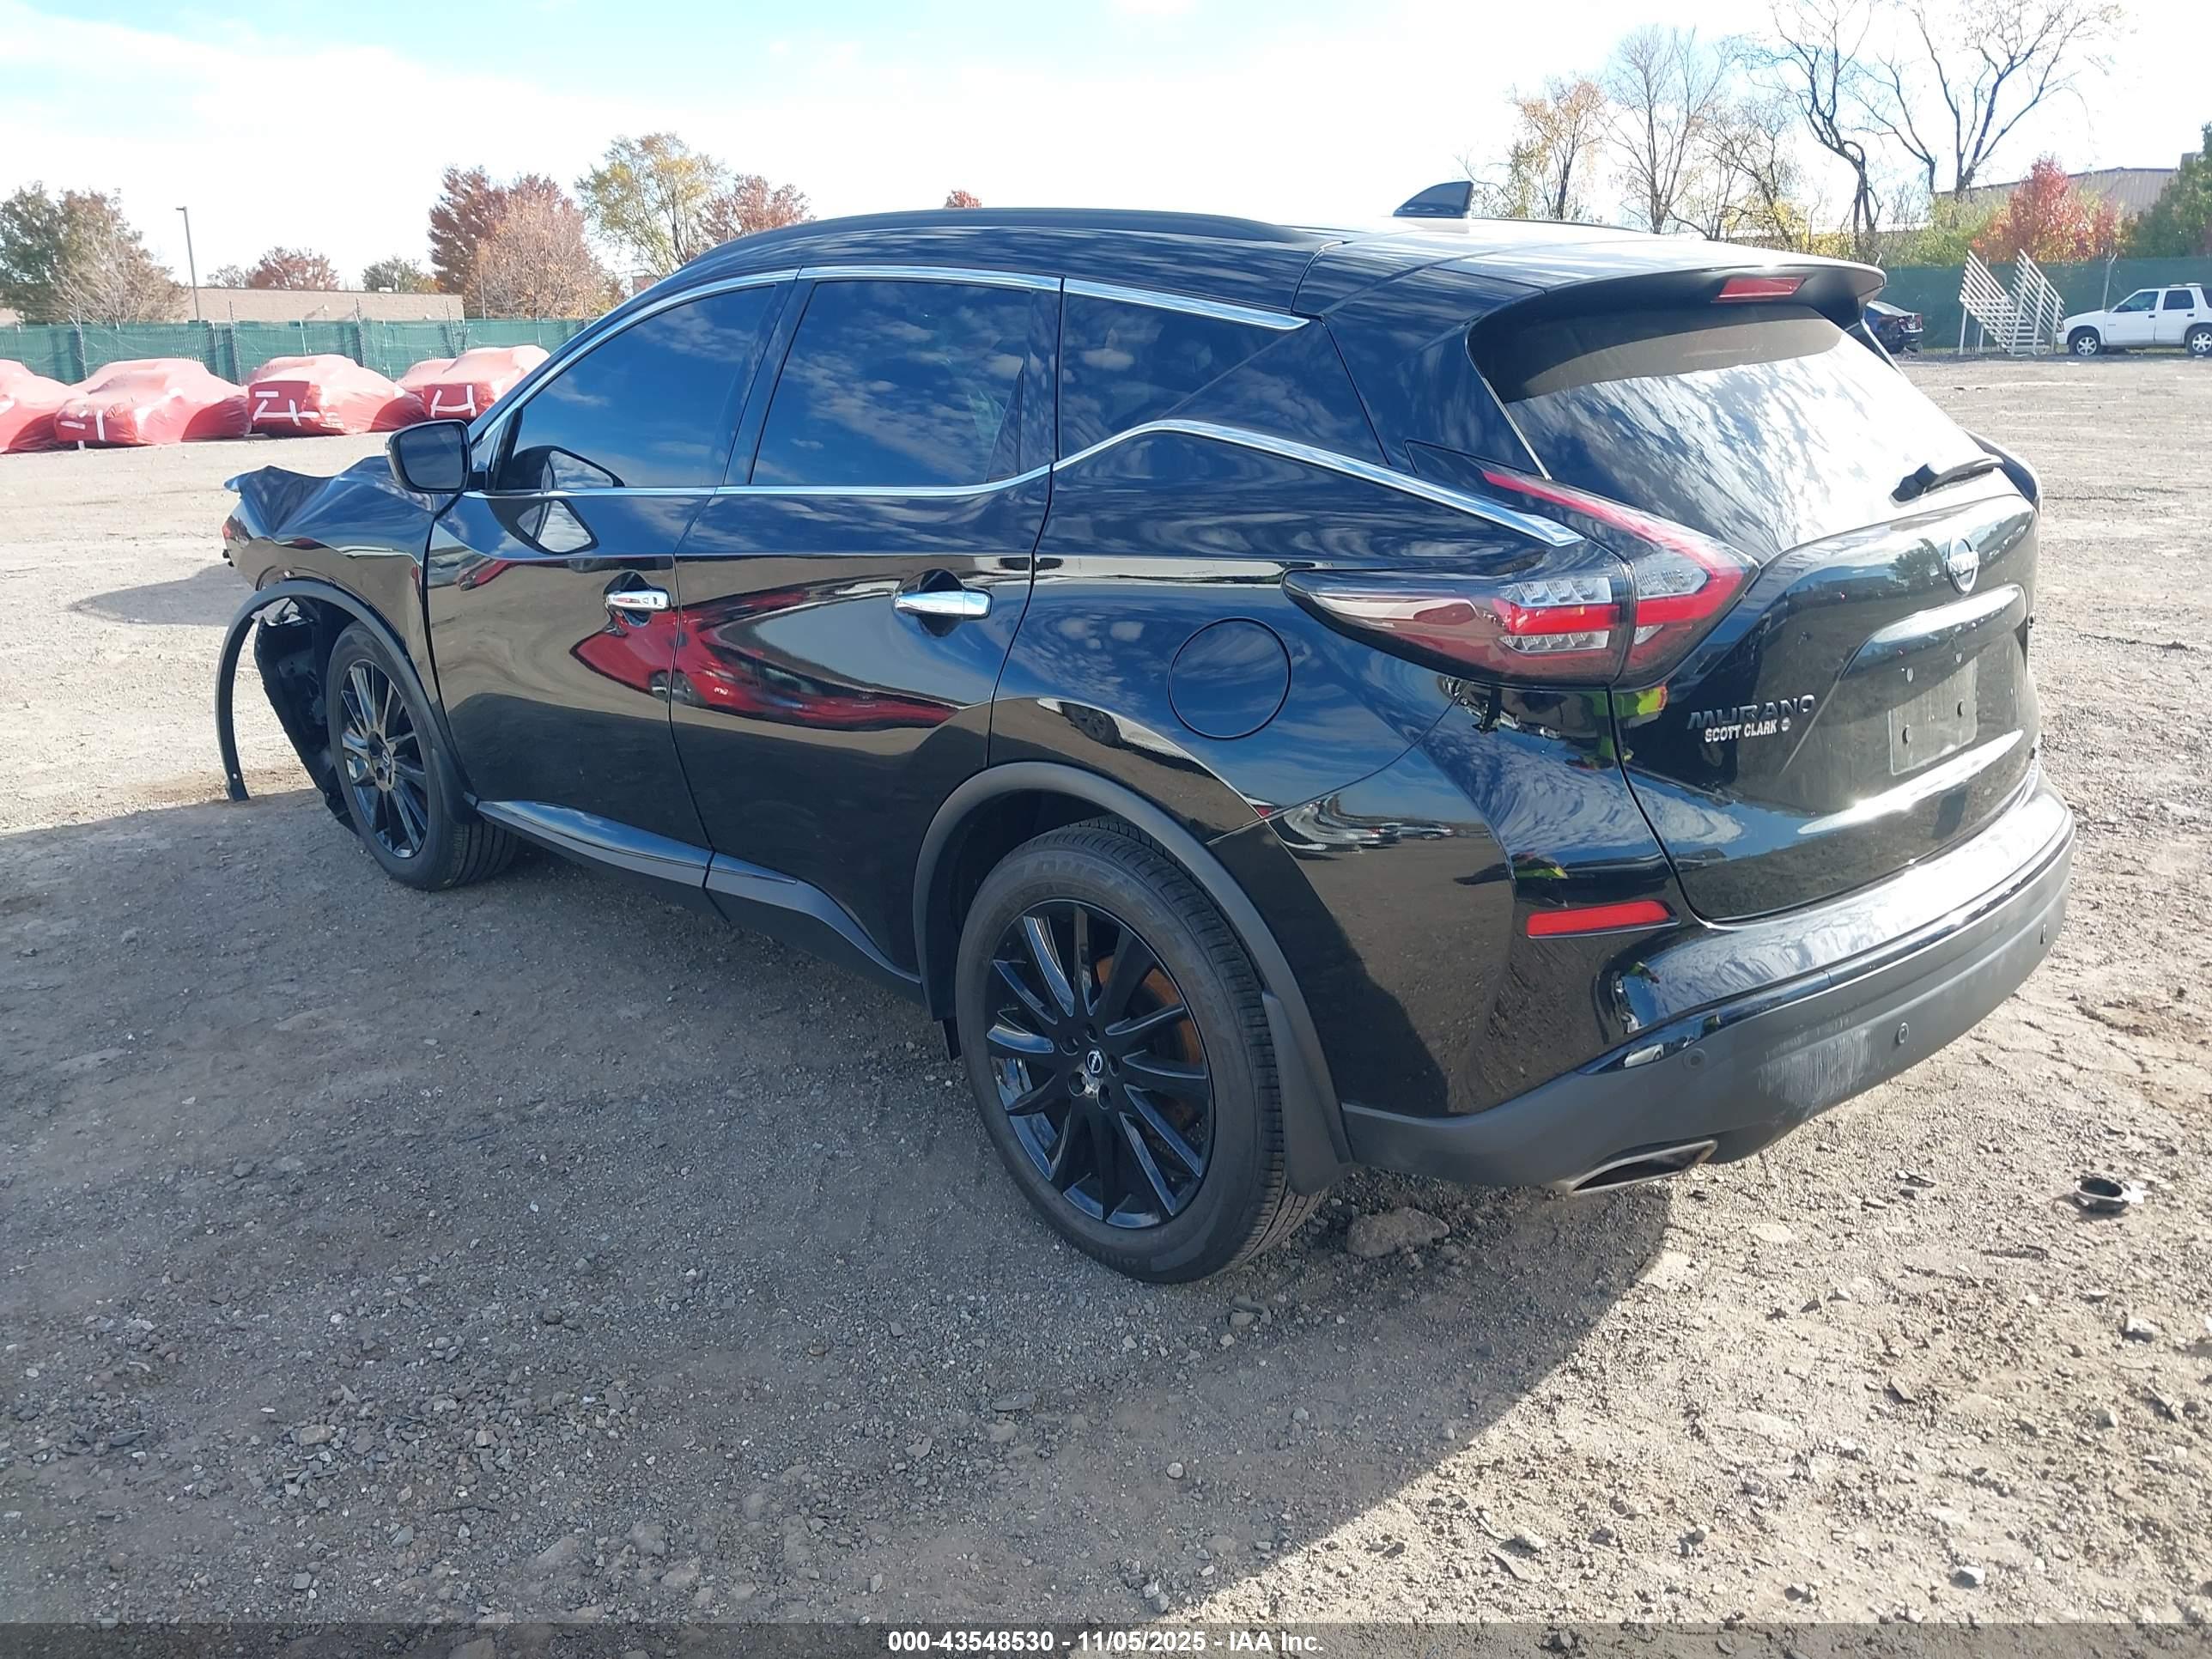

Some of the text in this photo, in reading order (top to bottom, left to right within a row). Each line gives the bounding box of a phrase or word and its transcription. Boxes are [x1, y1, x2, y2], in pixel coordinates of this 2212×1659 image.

[1687, 694, 1815, 730] MURANO
[1705, 724, 1742, 743] SCOTT
[1744, 719, 1778, 738] CLARK
